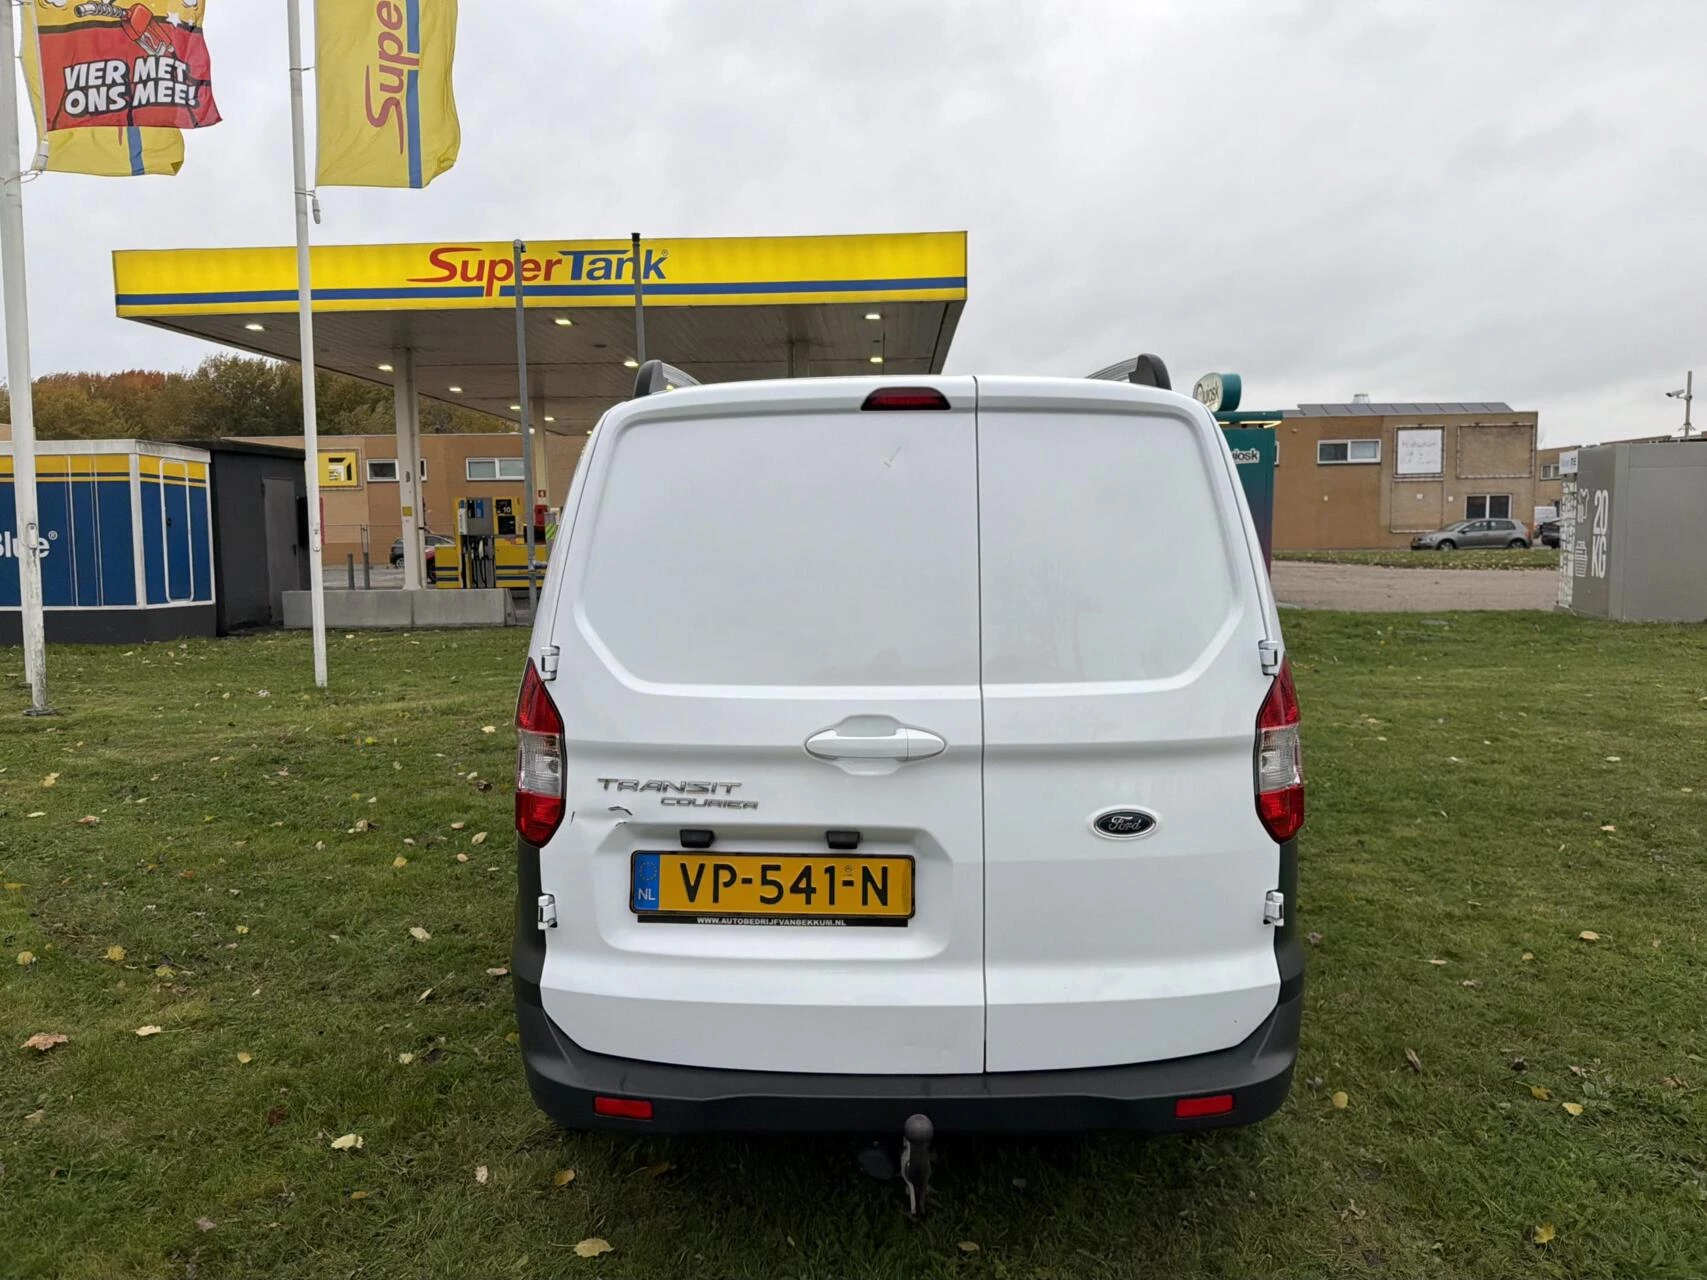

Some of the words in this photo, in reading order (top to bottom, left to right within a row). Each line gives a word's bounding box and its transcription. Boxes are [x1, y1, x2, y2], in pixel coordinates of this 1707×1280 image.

[64, 60, 127, 90] VIER
[133, 56, 186, 83] MET
[64, 85, 127, 115] ONS
[132, 81, 197, 107] MEE!
[1593, 489, 1609, 535] 20
[1591, 535, 1607, 578] KG
[597, 778, 742, 795] TRANSIT
[660, 797, 759, 810] COURIER
[1108, 815, 1142, 831] Ford
[638, 887, 657, 901] NL
[680, 863, 888, 906] VP-541-N
[696, 917, 847, 926] WWW.AUTOBEDRIJFVANBEKKUM.NL
